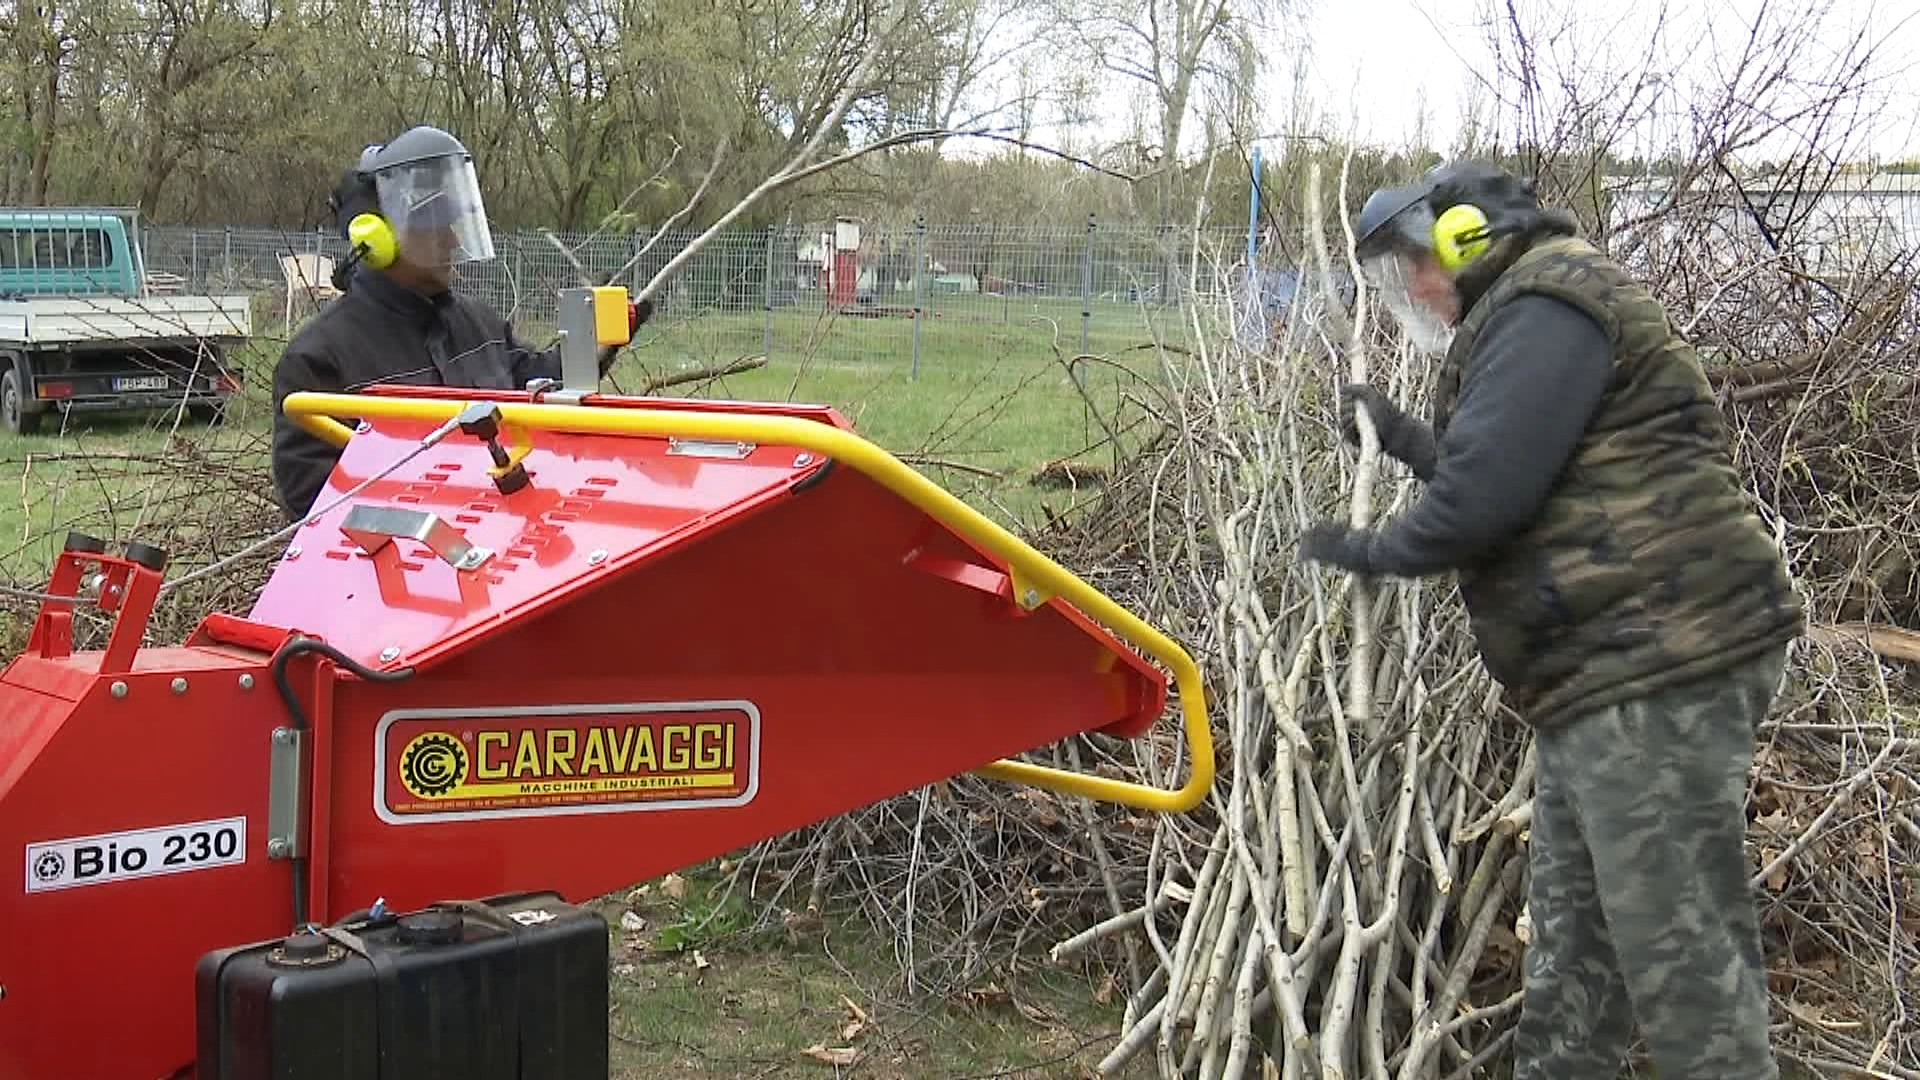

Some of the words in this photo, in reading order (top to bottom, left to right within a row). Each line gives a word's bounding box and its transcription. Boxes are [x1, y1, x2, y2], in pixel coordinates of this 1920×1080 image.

[477, 722, 736, 779] CARAVAGGI
[519, 780, 598, 794] MACCHINE
[603, 777, 695, 790] INDUSTRIALI
[73, 842, 148, 879] Bio
[163, 828, 238, 866] 230
